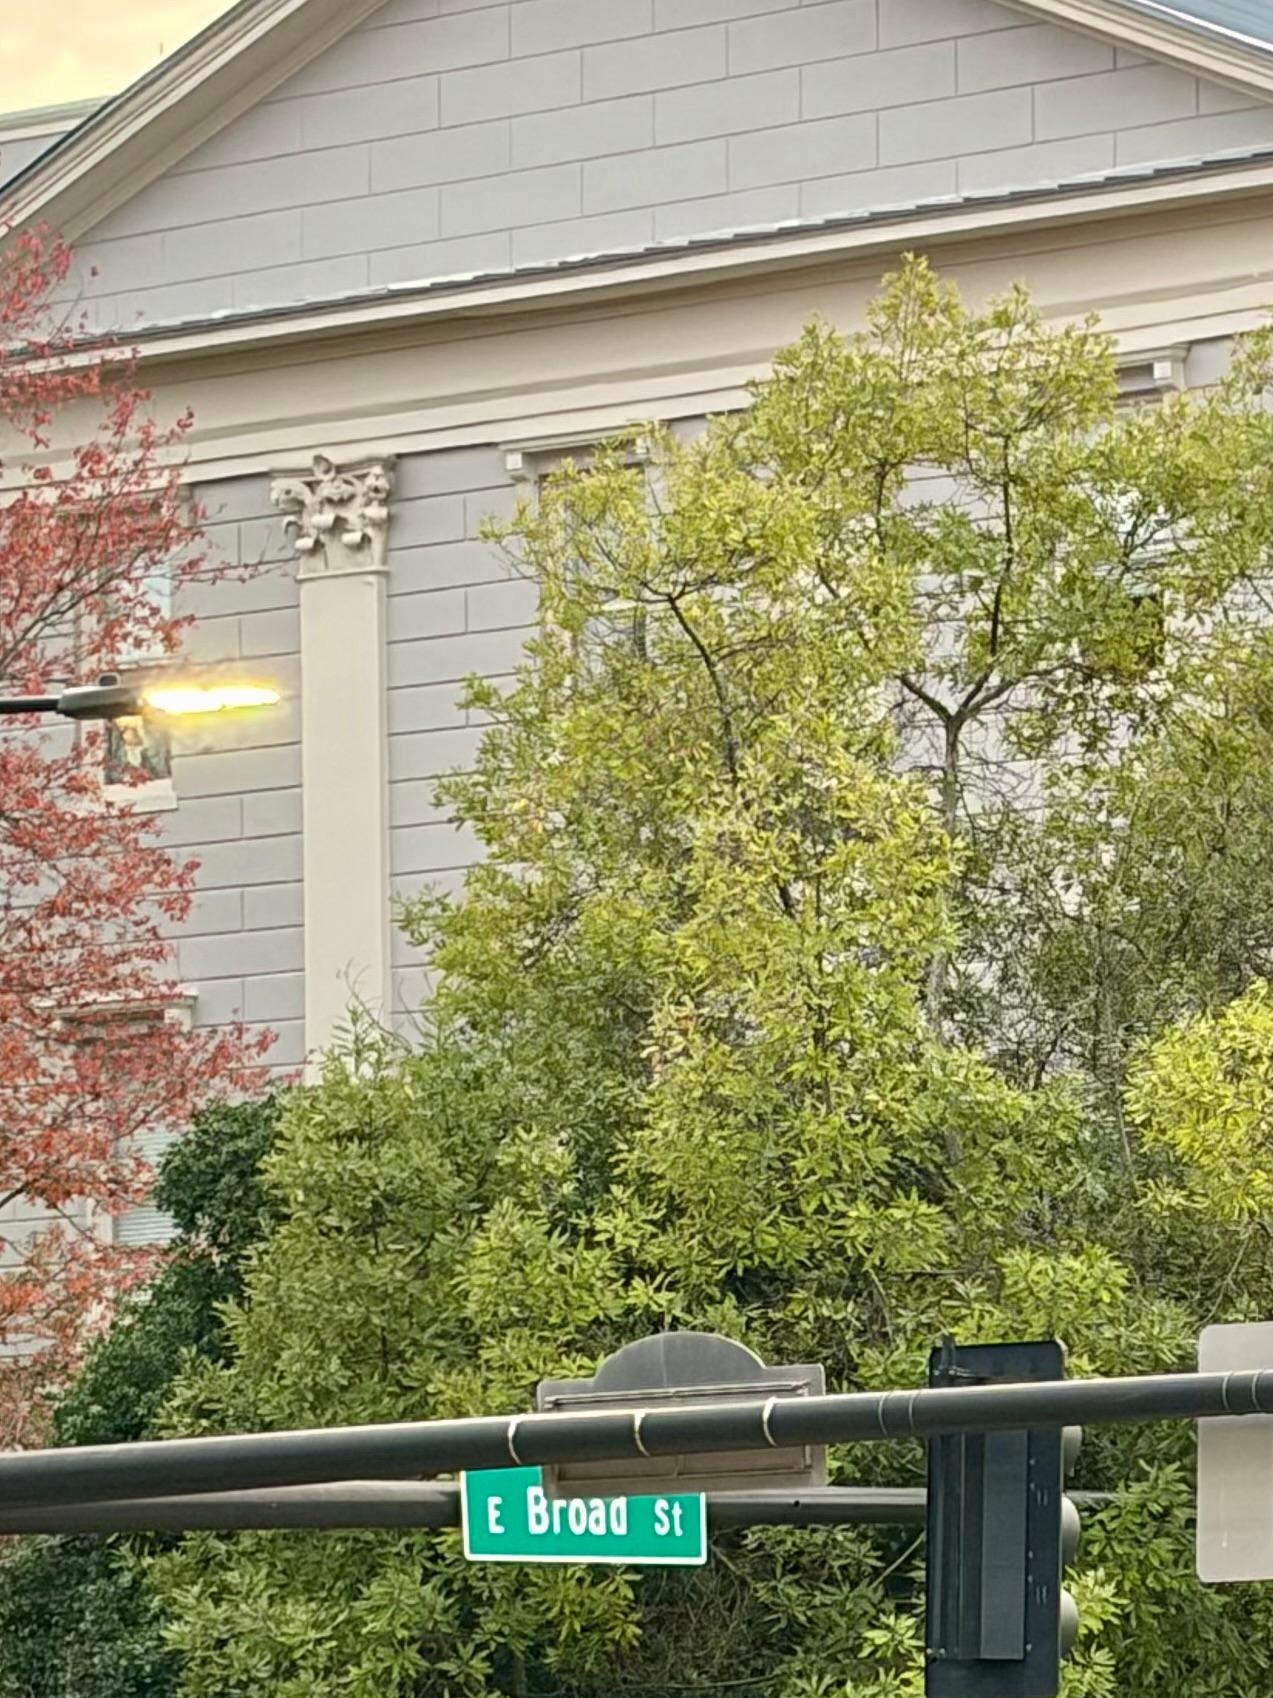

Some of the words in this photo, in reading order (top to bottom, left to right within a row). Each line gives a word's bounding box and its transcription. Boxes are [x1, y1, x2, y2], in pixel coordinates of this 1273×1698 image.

[487, 1496, 505, 1534] E
[526, 1486, 628, 1536] Broad
[654, 1498, 683, 1537] St
